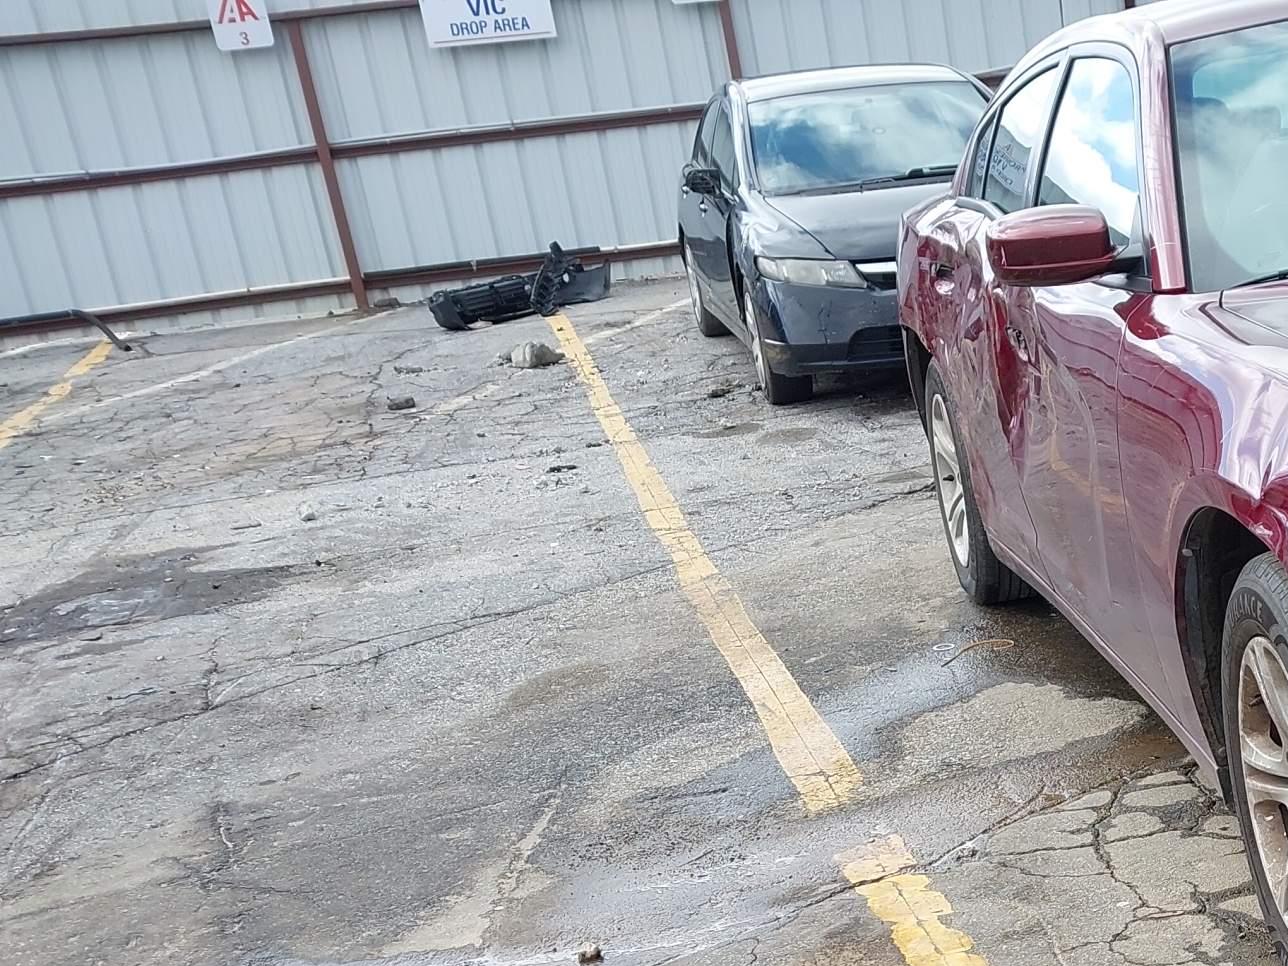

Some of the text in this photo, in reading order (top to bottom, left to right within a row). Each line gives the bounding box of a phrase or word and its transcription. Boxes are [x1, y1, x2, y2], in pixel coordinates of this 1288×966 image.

[466, 0, 506, 17] VIC
[450, 17, 531, 37] DROP AREA
[240, 31, 250, 46] 3
